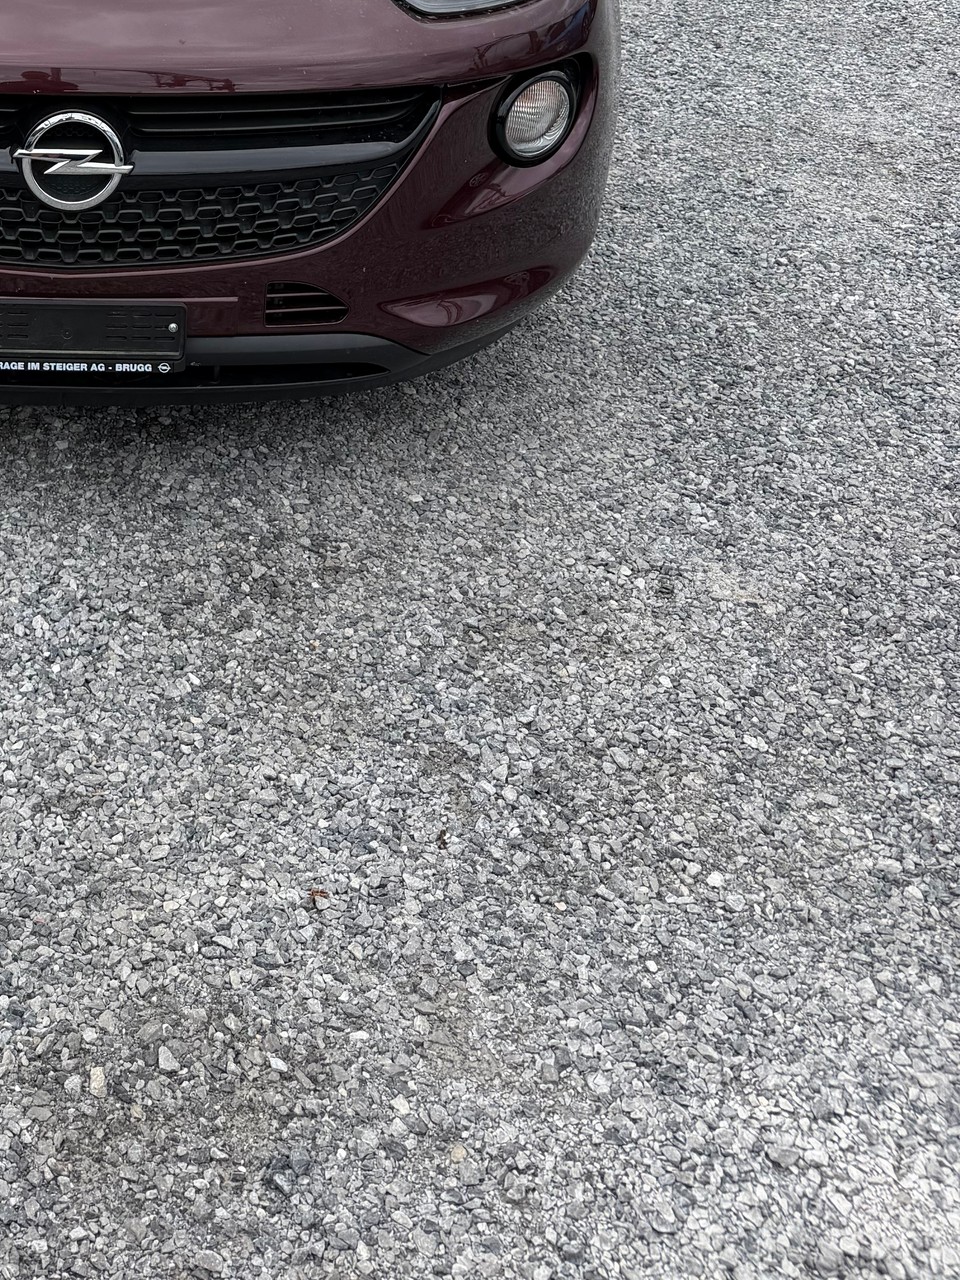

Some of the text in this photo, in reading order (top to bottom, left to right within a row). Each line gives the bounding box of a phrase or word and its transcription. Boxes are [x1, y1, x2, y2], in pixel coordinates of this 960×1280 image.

[27, 362, 40, 371] IM
[42, 362, 88, 372] STEIGER
[90, 363, 106, 372] AG
[115, 363, 153, 372] BRUGG
